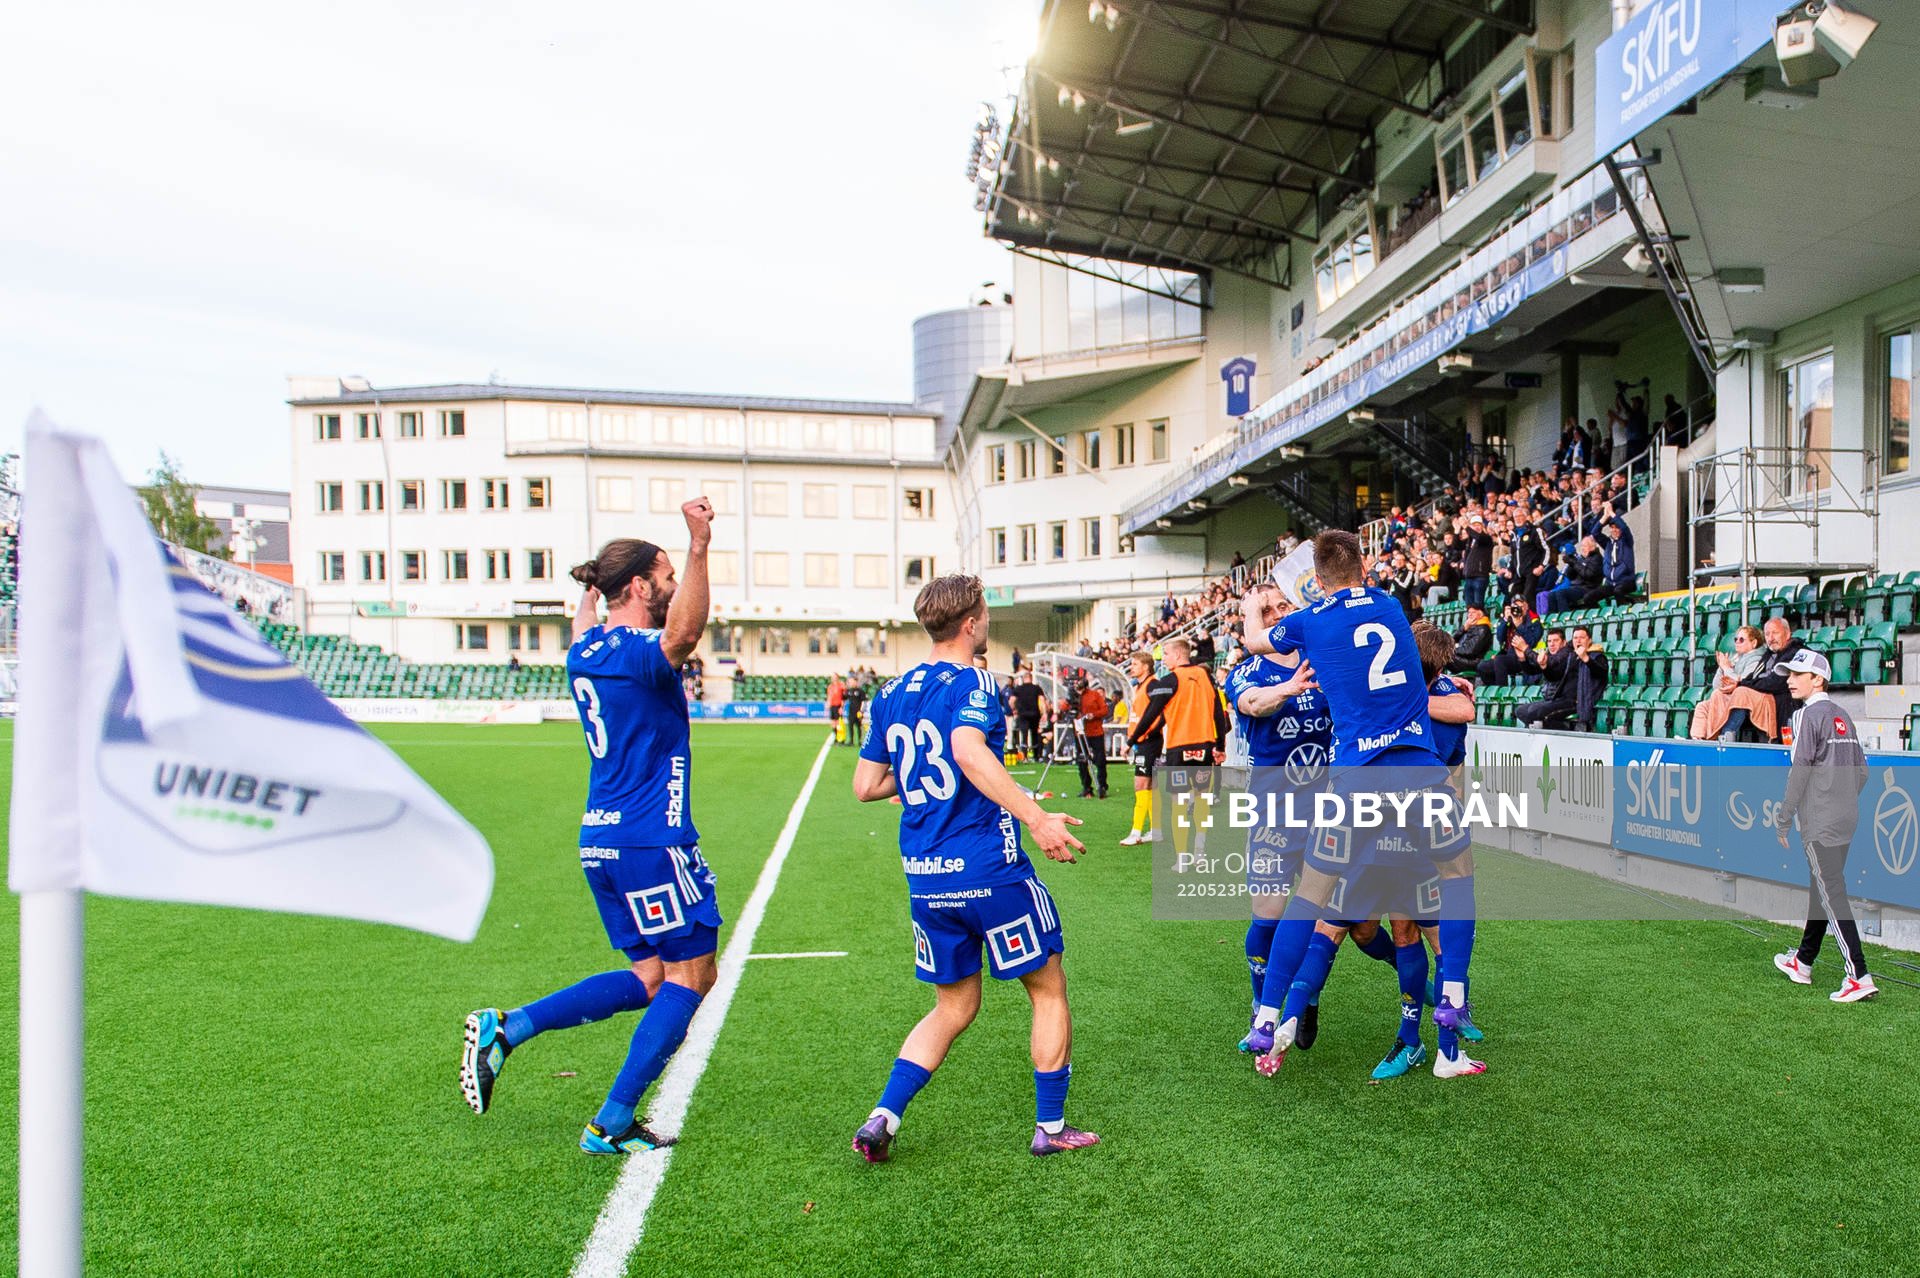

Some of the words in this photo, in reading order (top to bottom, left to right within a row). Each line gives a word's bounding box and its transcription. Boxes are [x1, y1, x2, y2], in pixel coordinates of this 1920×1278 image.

[1621, 0, 1701, 102] SKIFU
[1232, 373, 1245, 394] 10
[1353, 622, 1407, 691] 2
[573, 676, 608, 758] 3
[153, 761, 322, 816] UNIBET
[665, 755, 686, 828] stadium
[886, 718, 957, 806] 23
[1559, 756, 1605, 809] LILIUM
[1626, 748, 1702, 825] SKIFU
[1376, 836, 1418, 852] nbil.s
[1626, 821, 1661, 841] FASTIGHETER
[1665, 828, 1702, 848] SUNDSVALL
